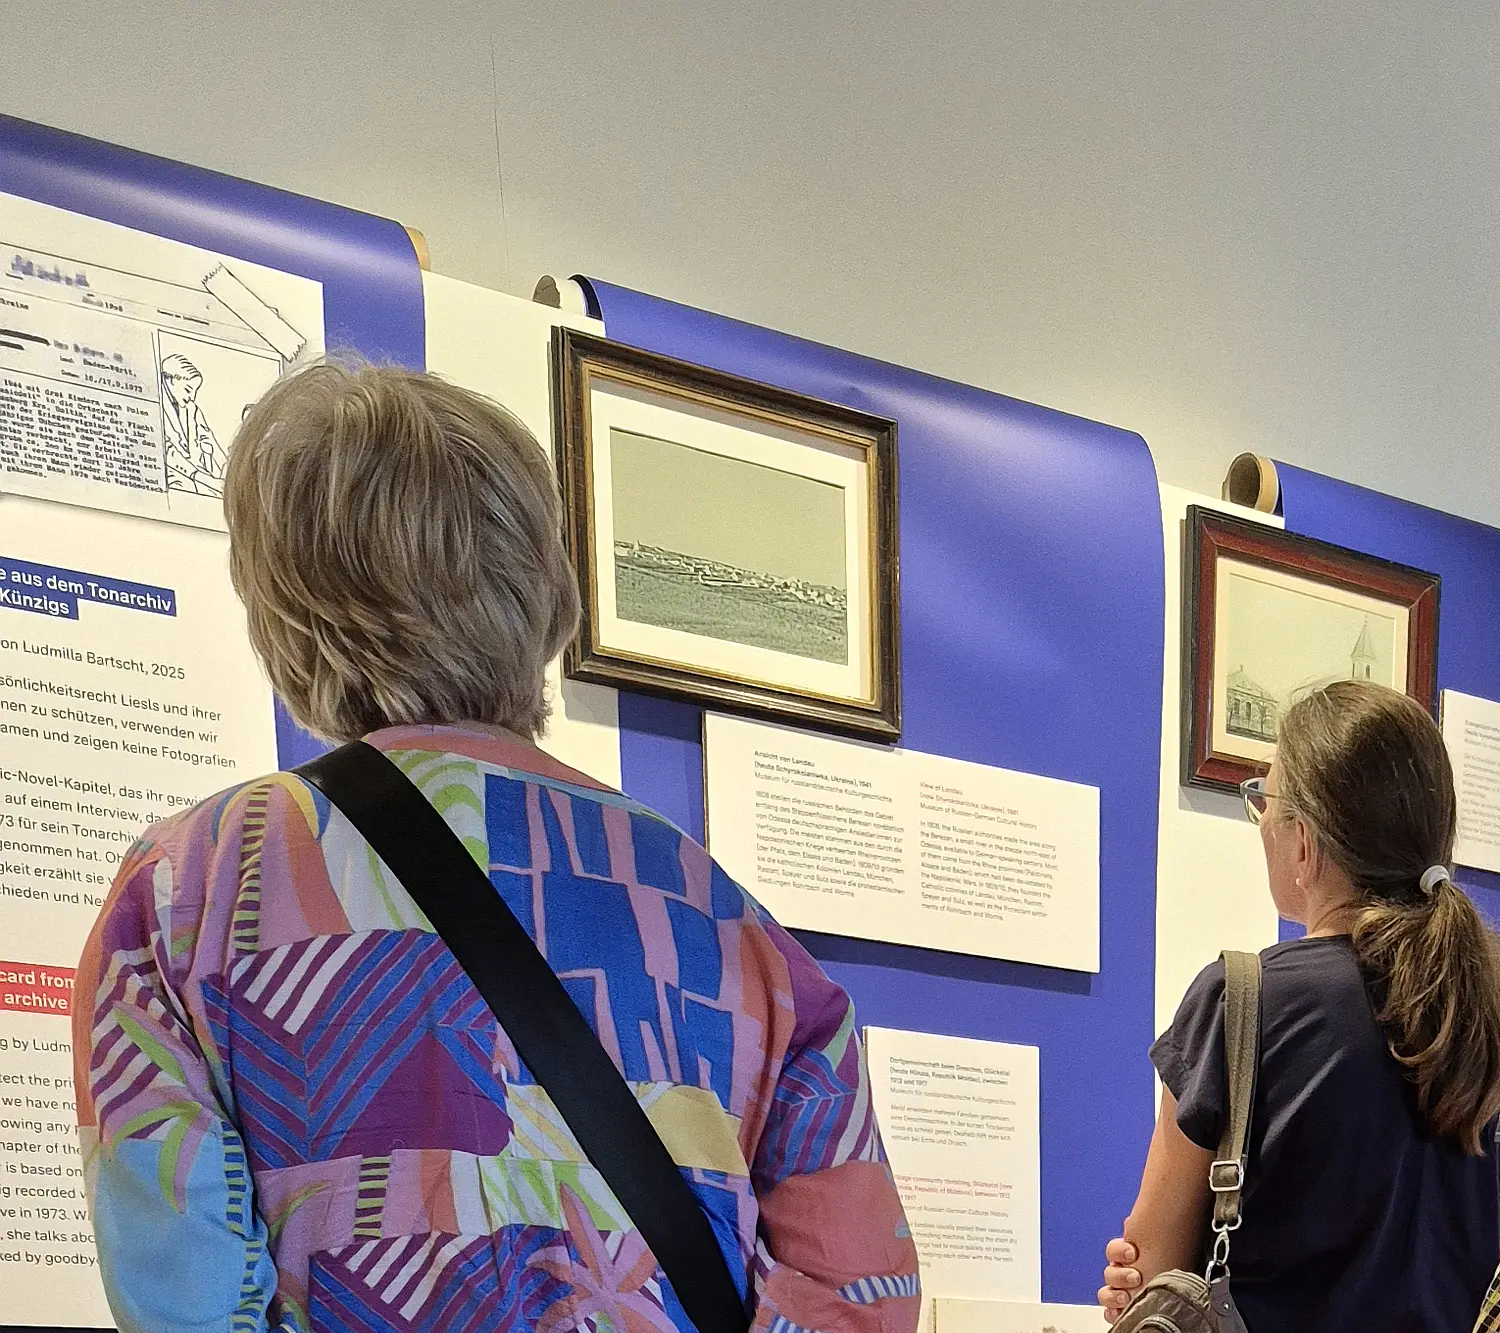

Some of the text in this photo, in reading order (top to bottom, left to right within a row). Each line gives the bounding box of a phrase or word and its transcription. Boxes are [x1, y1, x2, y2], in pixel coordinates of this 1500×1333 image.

[11, 571, 42, 586] aus
[46, 575, 83, 594] dem
[86, 582, 171, 611] Tonarchiv
[0, 588, 69, 616] Künzigs
[23, 640, 82, 661] Ludmilla
[87, 651, 148, 675] Bartscht,
[151, 663, 184, 679] 2025
[121, 694, 159, 711] Liesls
[163, 704, 187, 716] und
[192, 706, 221, 720] ihrer
[31, 705, 47, 716] zu
[51, 708, 117, 729] schützen,
[121, 720, 194, 739] verwenden
[198, 731, 217, 742] wir
[43, 730, 69, 742] und
[74, 734, 118, 750] zeigen
[122, 740, 157, 756] keine
[161, 746, 235, 767] Fotografien
[119, 786, 142, 799] das
[147, 789, 163, 801] ihr
[5, 794, 26, 805] auf
[31, 796, 72, 811] einem
[77, 802, 142, 823] Interview,
[18, 816, 37, 829] für
[41, 821, 69, 834] sein
[76, 847, 101, 861] hat.
[34, 867, 82, 881] erzählt
[86, 872, 104, 884] sie
[0, 883, 48, 900] hieden
[53, 893, 78, 903] und
[4, 991, 68, 1009] archive
[12, 1037, 28, 1051] by
[28, 1074, 50, 1086] the
[54, 1076, 74, 1089] pri
[1, 1097, 22, 1106] we
[25, 1096, 58, 1109] have
[0, 1118, 70, 1134] owing any
[46, 1142, 58, 1153] of
[5, 1161, 16, 1173] is
[20, 1163, 61, 1176] based
[0, 1186, 75, 1198] g recorded
[20, 1207, 31, 1218] in
[35, 1208, 70, 1220] 1973.
[6, 1229, 30, 1240] she
[35, 1230, 67, 1241] talks
[25, 1251, 41, 1264] by
